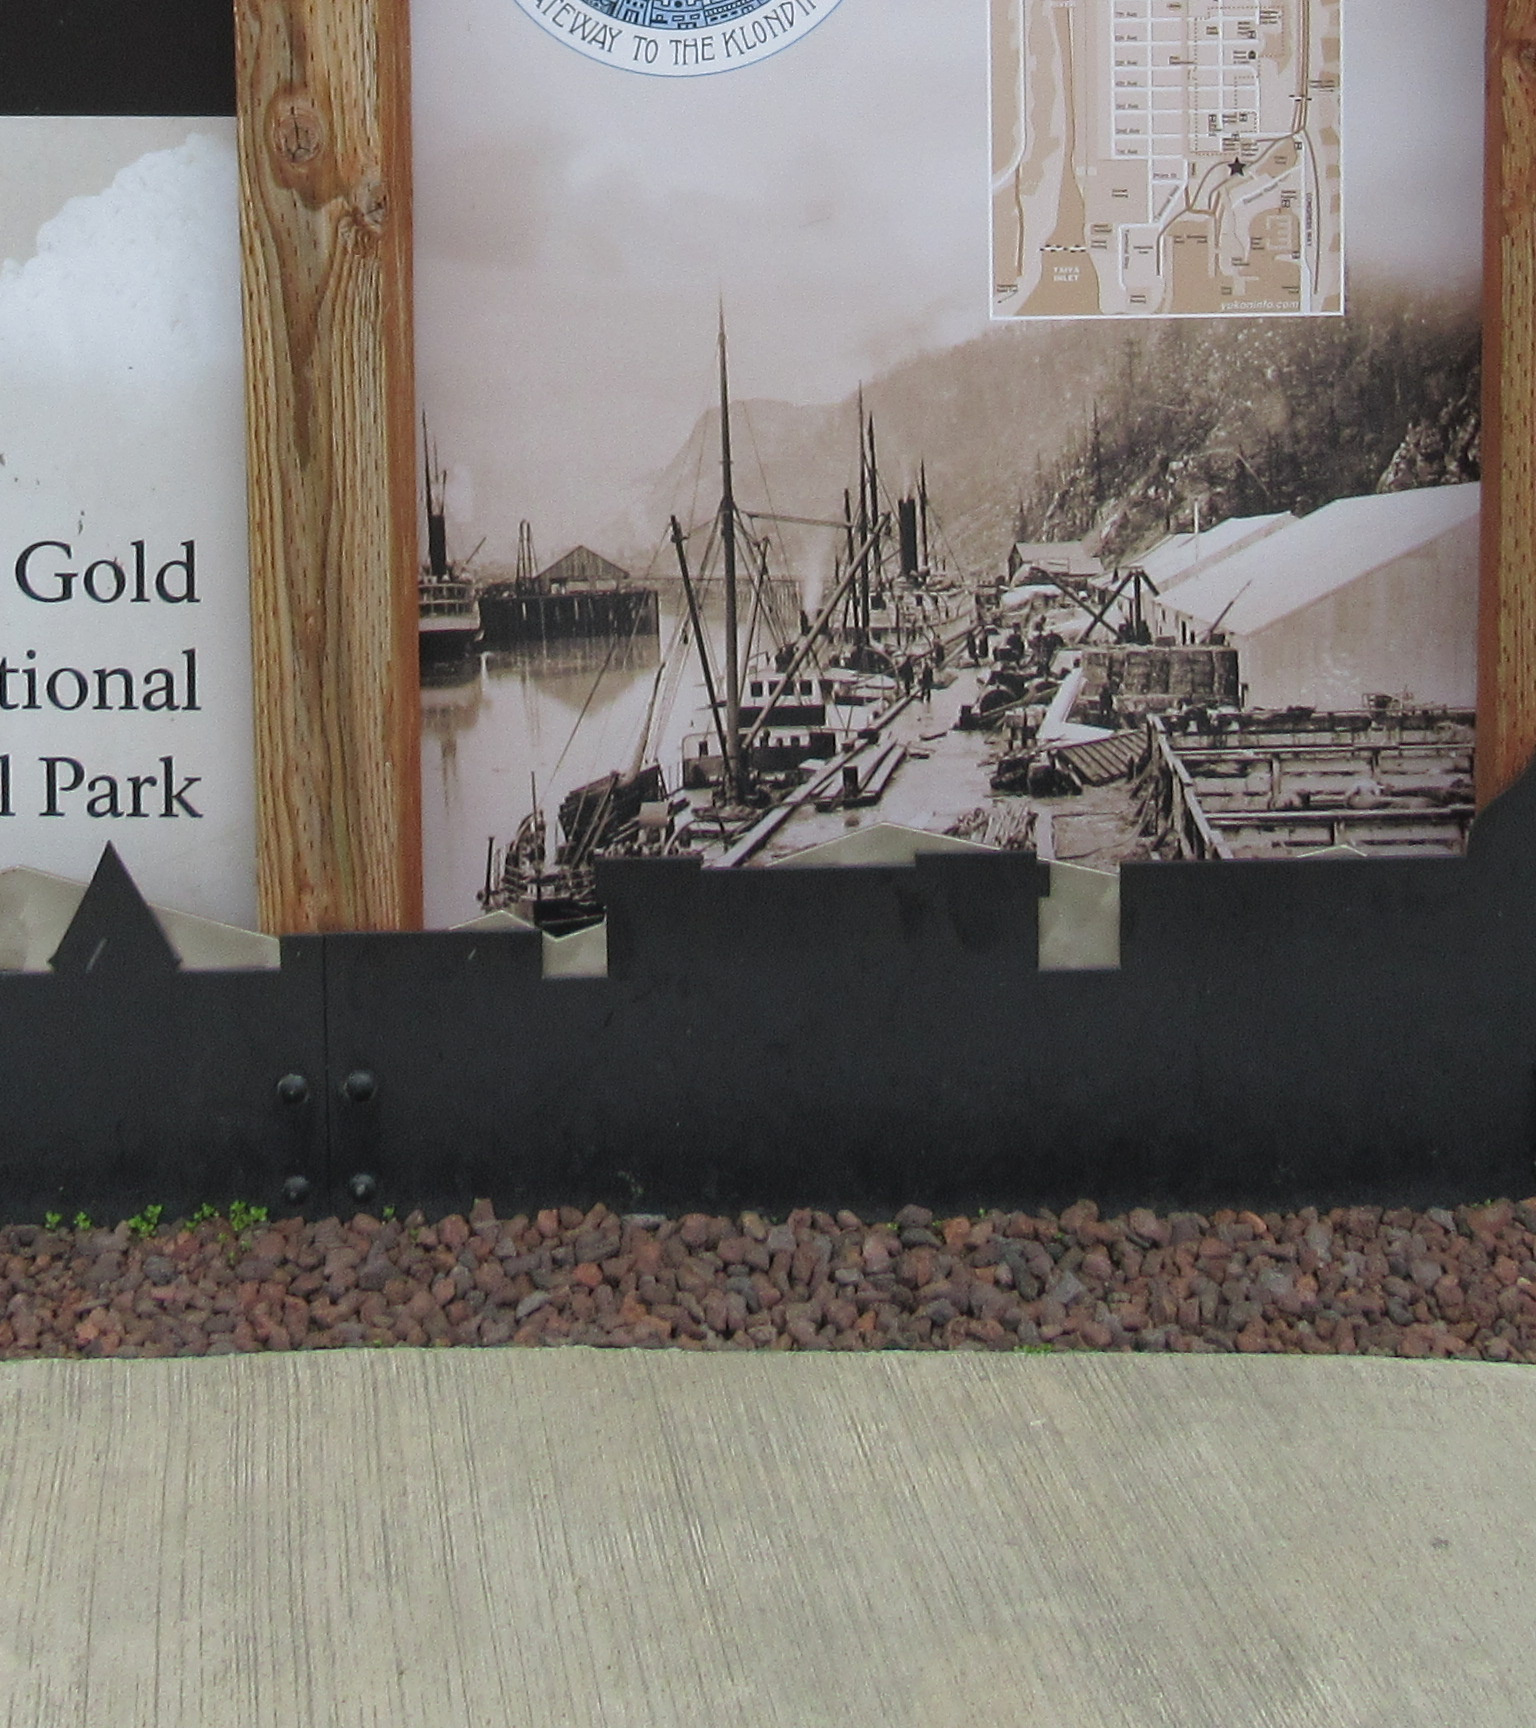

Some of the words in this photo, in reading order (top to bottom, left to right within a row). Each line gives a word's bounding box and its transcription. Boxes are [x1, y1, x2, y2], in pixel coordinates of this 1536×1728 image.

[632, 35, 659, 64] TO
[670, 36, 715, 65] THE
[1053, 274, 1079, 282] INLET
[14, 538, 202, 605] Gold
[37, 754, 204, 819] Park
